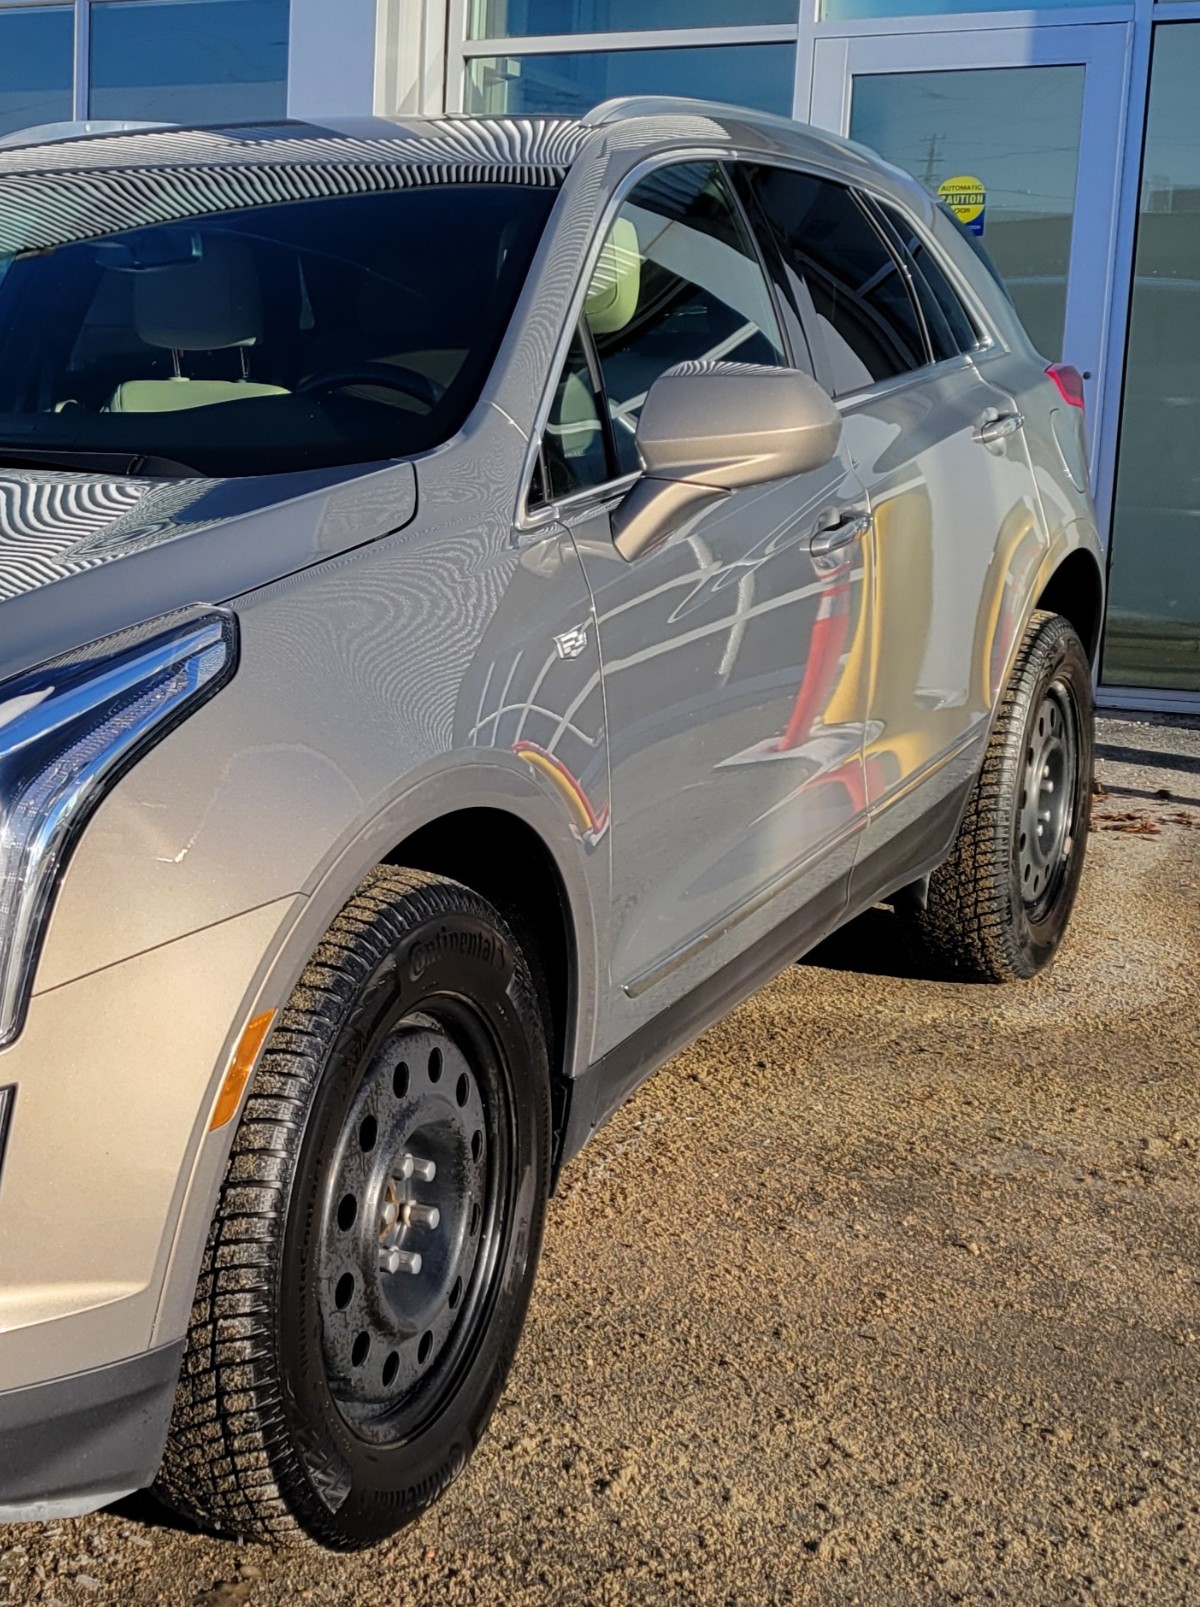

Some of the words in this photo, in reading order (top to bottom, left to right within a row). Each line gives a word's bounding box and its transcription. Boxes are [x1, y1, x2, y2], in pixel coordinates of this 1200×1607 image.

[941, 184, 983, 192] AUTOMATIC
[943, 194, 984, 205] AUTION
[408, 925, 497, 982] Continental
